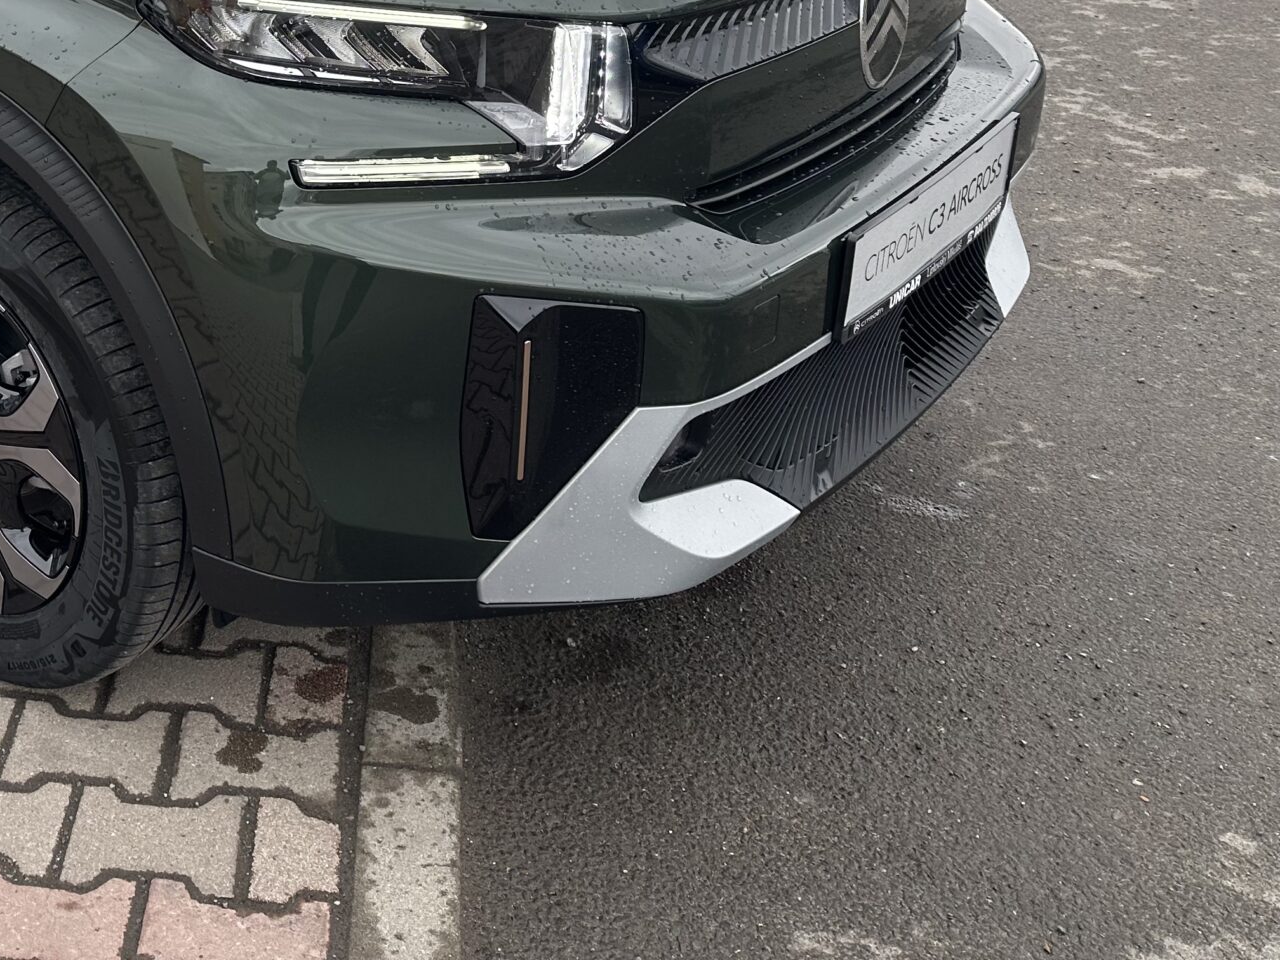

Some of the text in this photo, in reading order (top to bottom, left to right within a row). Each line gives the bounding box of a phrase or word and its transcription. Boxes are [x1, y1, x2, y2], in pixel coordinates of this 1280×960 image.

[864, 218, 927, 282] CITROËN
[928, 203, 946, 235] C3
[947, 153, 1004, 221] AIRCROSS
[888, 273, 922, 309] UNICAR
[86, 455, 122, 628] BRIDGESTONE
